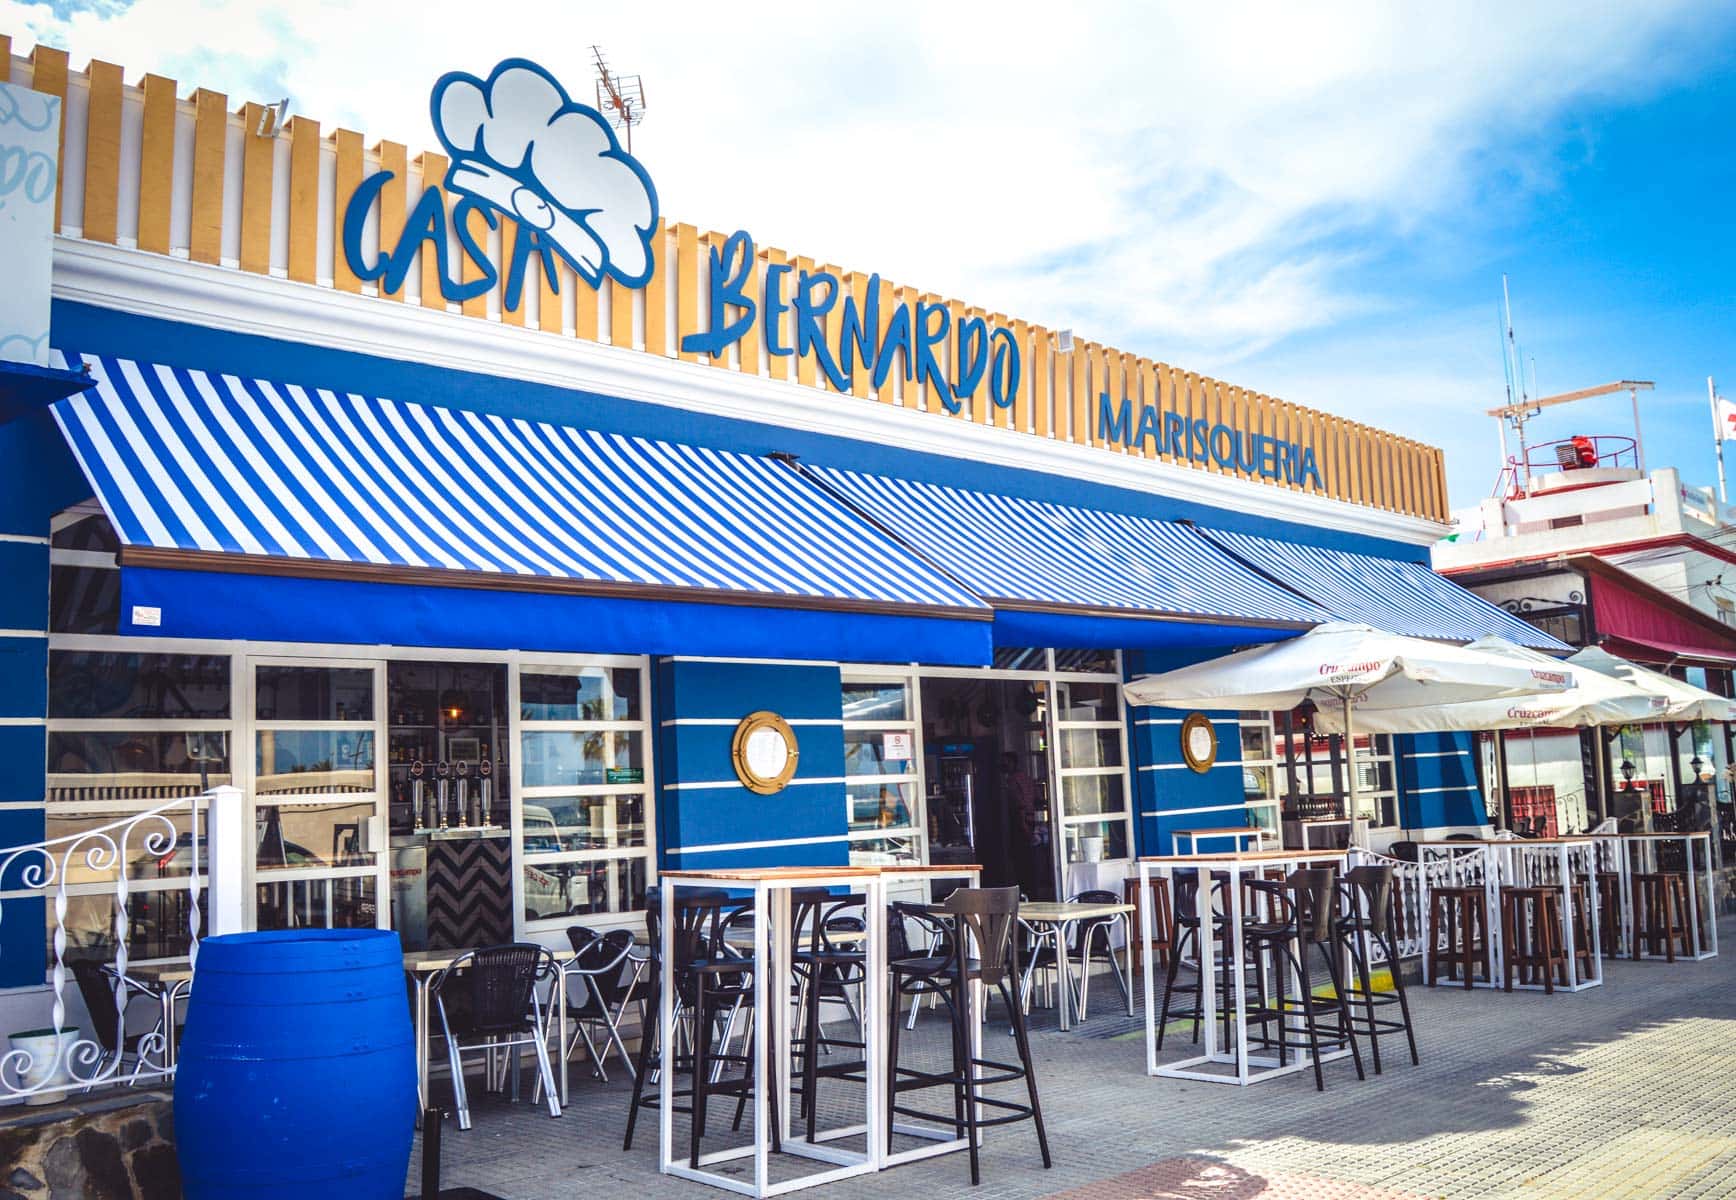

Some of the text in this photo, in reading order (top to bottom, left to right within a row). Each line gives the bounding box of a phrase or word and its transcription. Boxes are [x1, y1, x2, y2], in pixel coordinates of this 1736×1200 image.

[342, 169, 1021, 415] CASA BERNARDO
[1098, 391, 1324, 490] MARISQUERIA
